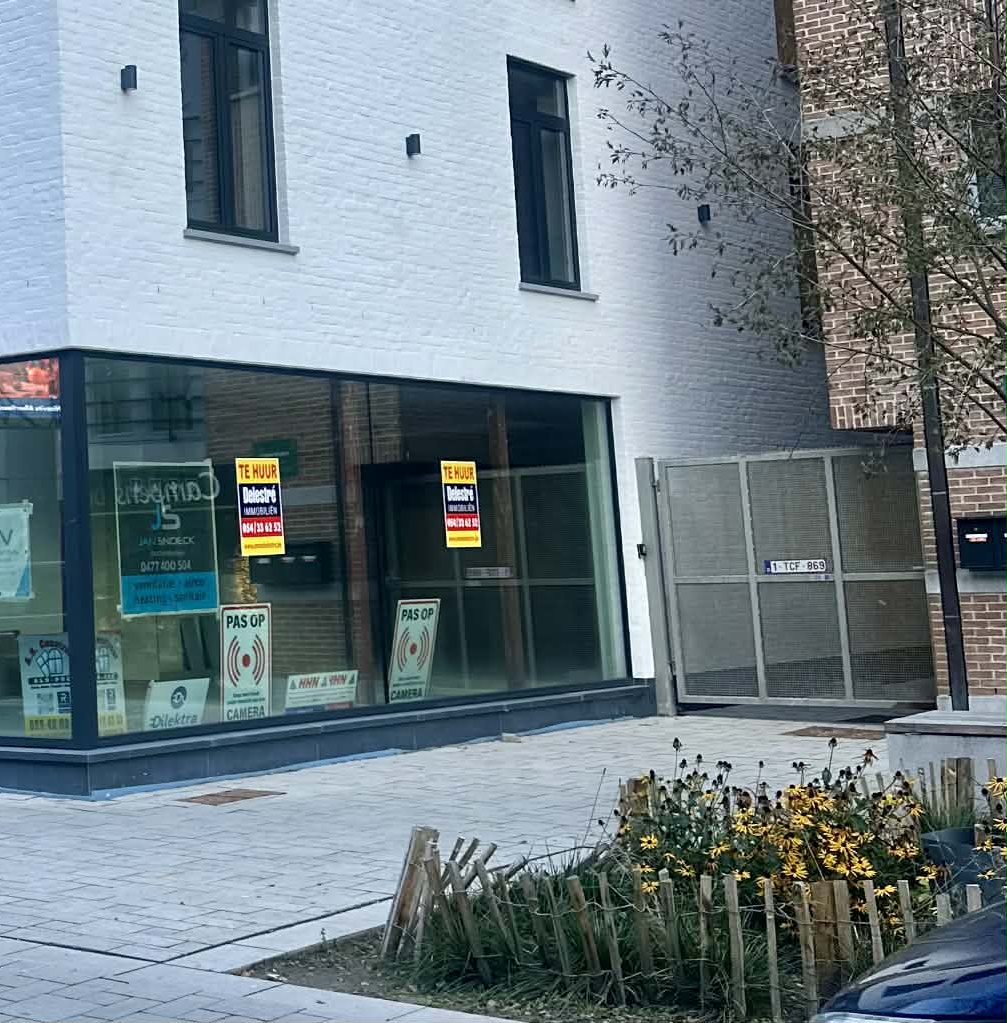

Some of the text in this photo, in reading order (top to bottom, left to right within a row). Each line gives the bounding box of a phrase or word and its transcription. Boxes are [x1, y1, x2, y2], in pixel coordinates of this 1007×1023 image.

[238, 464, 277, 479] TE HUUR
[443, 466, 474, 480] TE HUUR
[242, 485, 277, 503] Delestré
[242, 521, 282, 534] 054/33 62 52
[226, 614, 265, 629] PAS OP
[401, 607, 434, 622] PAS OP
[390, 687, 422, 701] CAMERA
[226, 705, 265, 721] CAMERA
